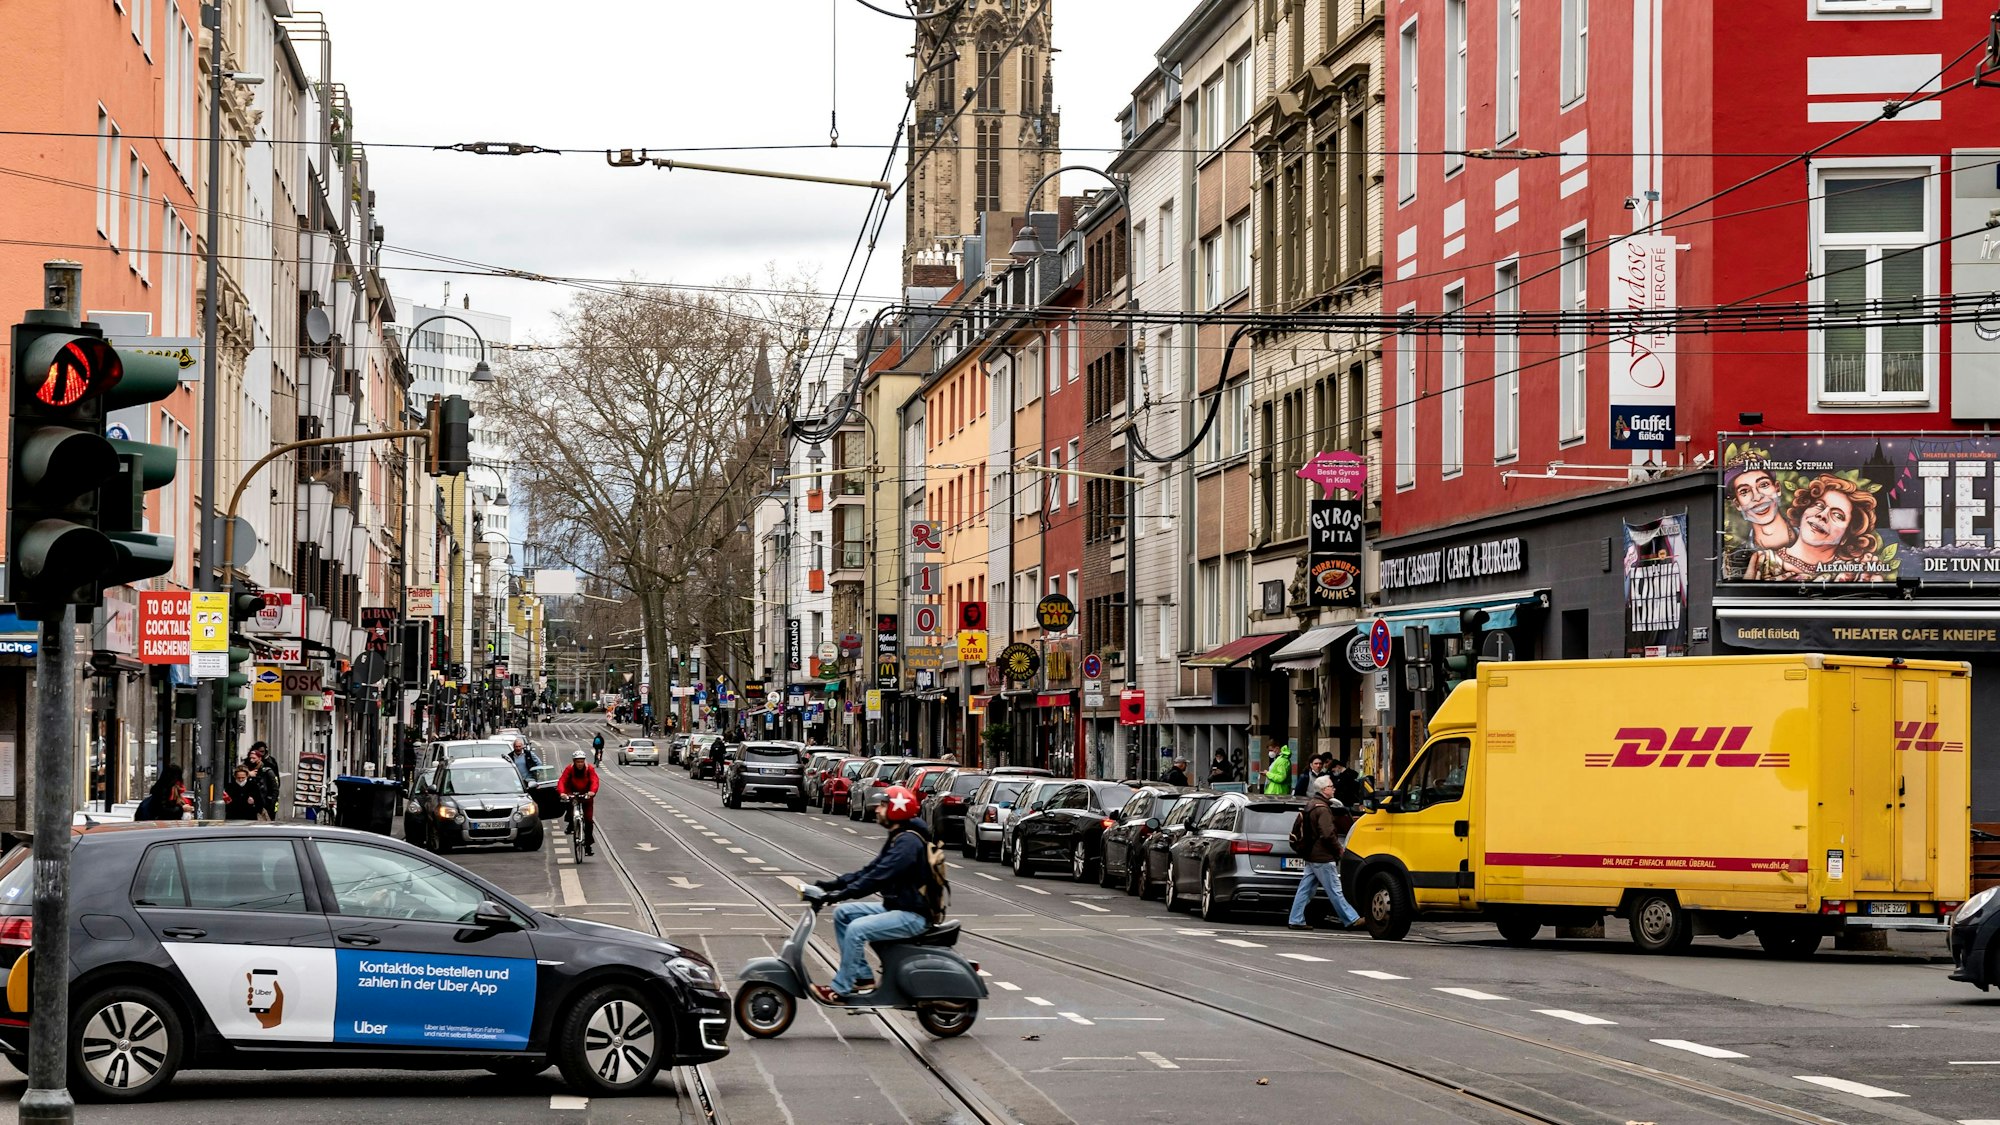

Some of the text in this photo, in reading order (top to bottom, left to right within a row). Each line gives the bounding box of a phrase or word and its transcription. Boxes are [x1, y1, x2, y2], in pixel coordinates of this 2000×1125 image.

[1630, 414, 1672, 432] Gaffel
[1638, 431, 1664, 442] Kölsch
[1744, 459, 1834, 472] JAN NIKLAS STEPHAN
[1317, 468, 1360, 477] Beste Gyros
[1334, 476, 1351, 484] Köln
[1918, 461, 2000, 548] TE
[1312, 507, 1362, 531] GYROS
[1322, 530, 1353, 543] PITA
[1311, 560, 1361, 577] CURRYWURST
[1380, 537, 1521, 589] BUTCH CASSIDY CAFE & BURGER
[1816, 562, 1891, 572] ALEXANDER MOLL
[1924, 558, 1948, 572] DIE
[1950, 558, 1980, 572] TUN
[408, 587, 433, 598] Falafel
[1314, 586, 1356, 600] POMMES
[147, 599, 159, 615] TO
[161, 599, 174, 615] GO
[1039, 602, 1072, 614] SOUL
[1043, 614, 1068, 625] BAR
[878, 634, 897, 642] Kebab
[1738, 628, 1996, 641] Gaffel Kölsch THEATER CAFE KNEIPE
[789, 620, 799, 670] BORSALINO
[908, 648, 933, 656] SPIEL
[908, 659, 940, 667] SALON
[1611, 726, 1762, 768] DHL
[1602, 858, 1614, 866] DHL
[1615, 858, 1634, 866] PAKET
[1639, 859, 1664, 867] EINFACH.
[1688, 858, 1717, 868] ÜBERALL.
[359, 961, 509, 980] Kontaktlos bestellen und
[358, 977, 498, 996] zahlen in der Uber App
[354, 1021, 388, 1034] Uber
